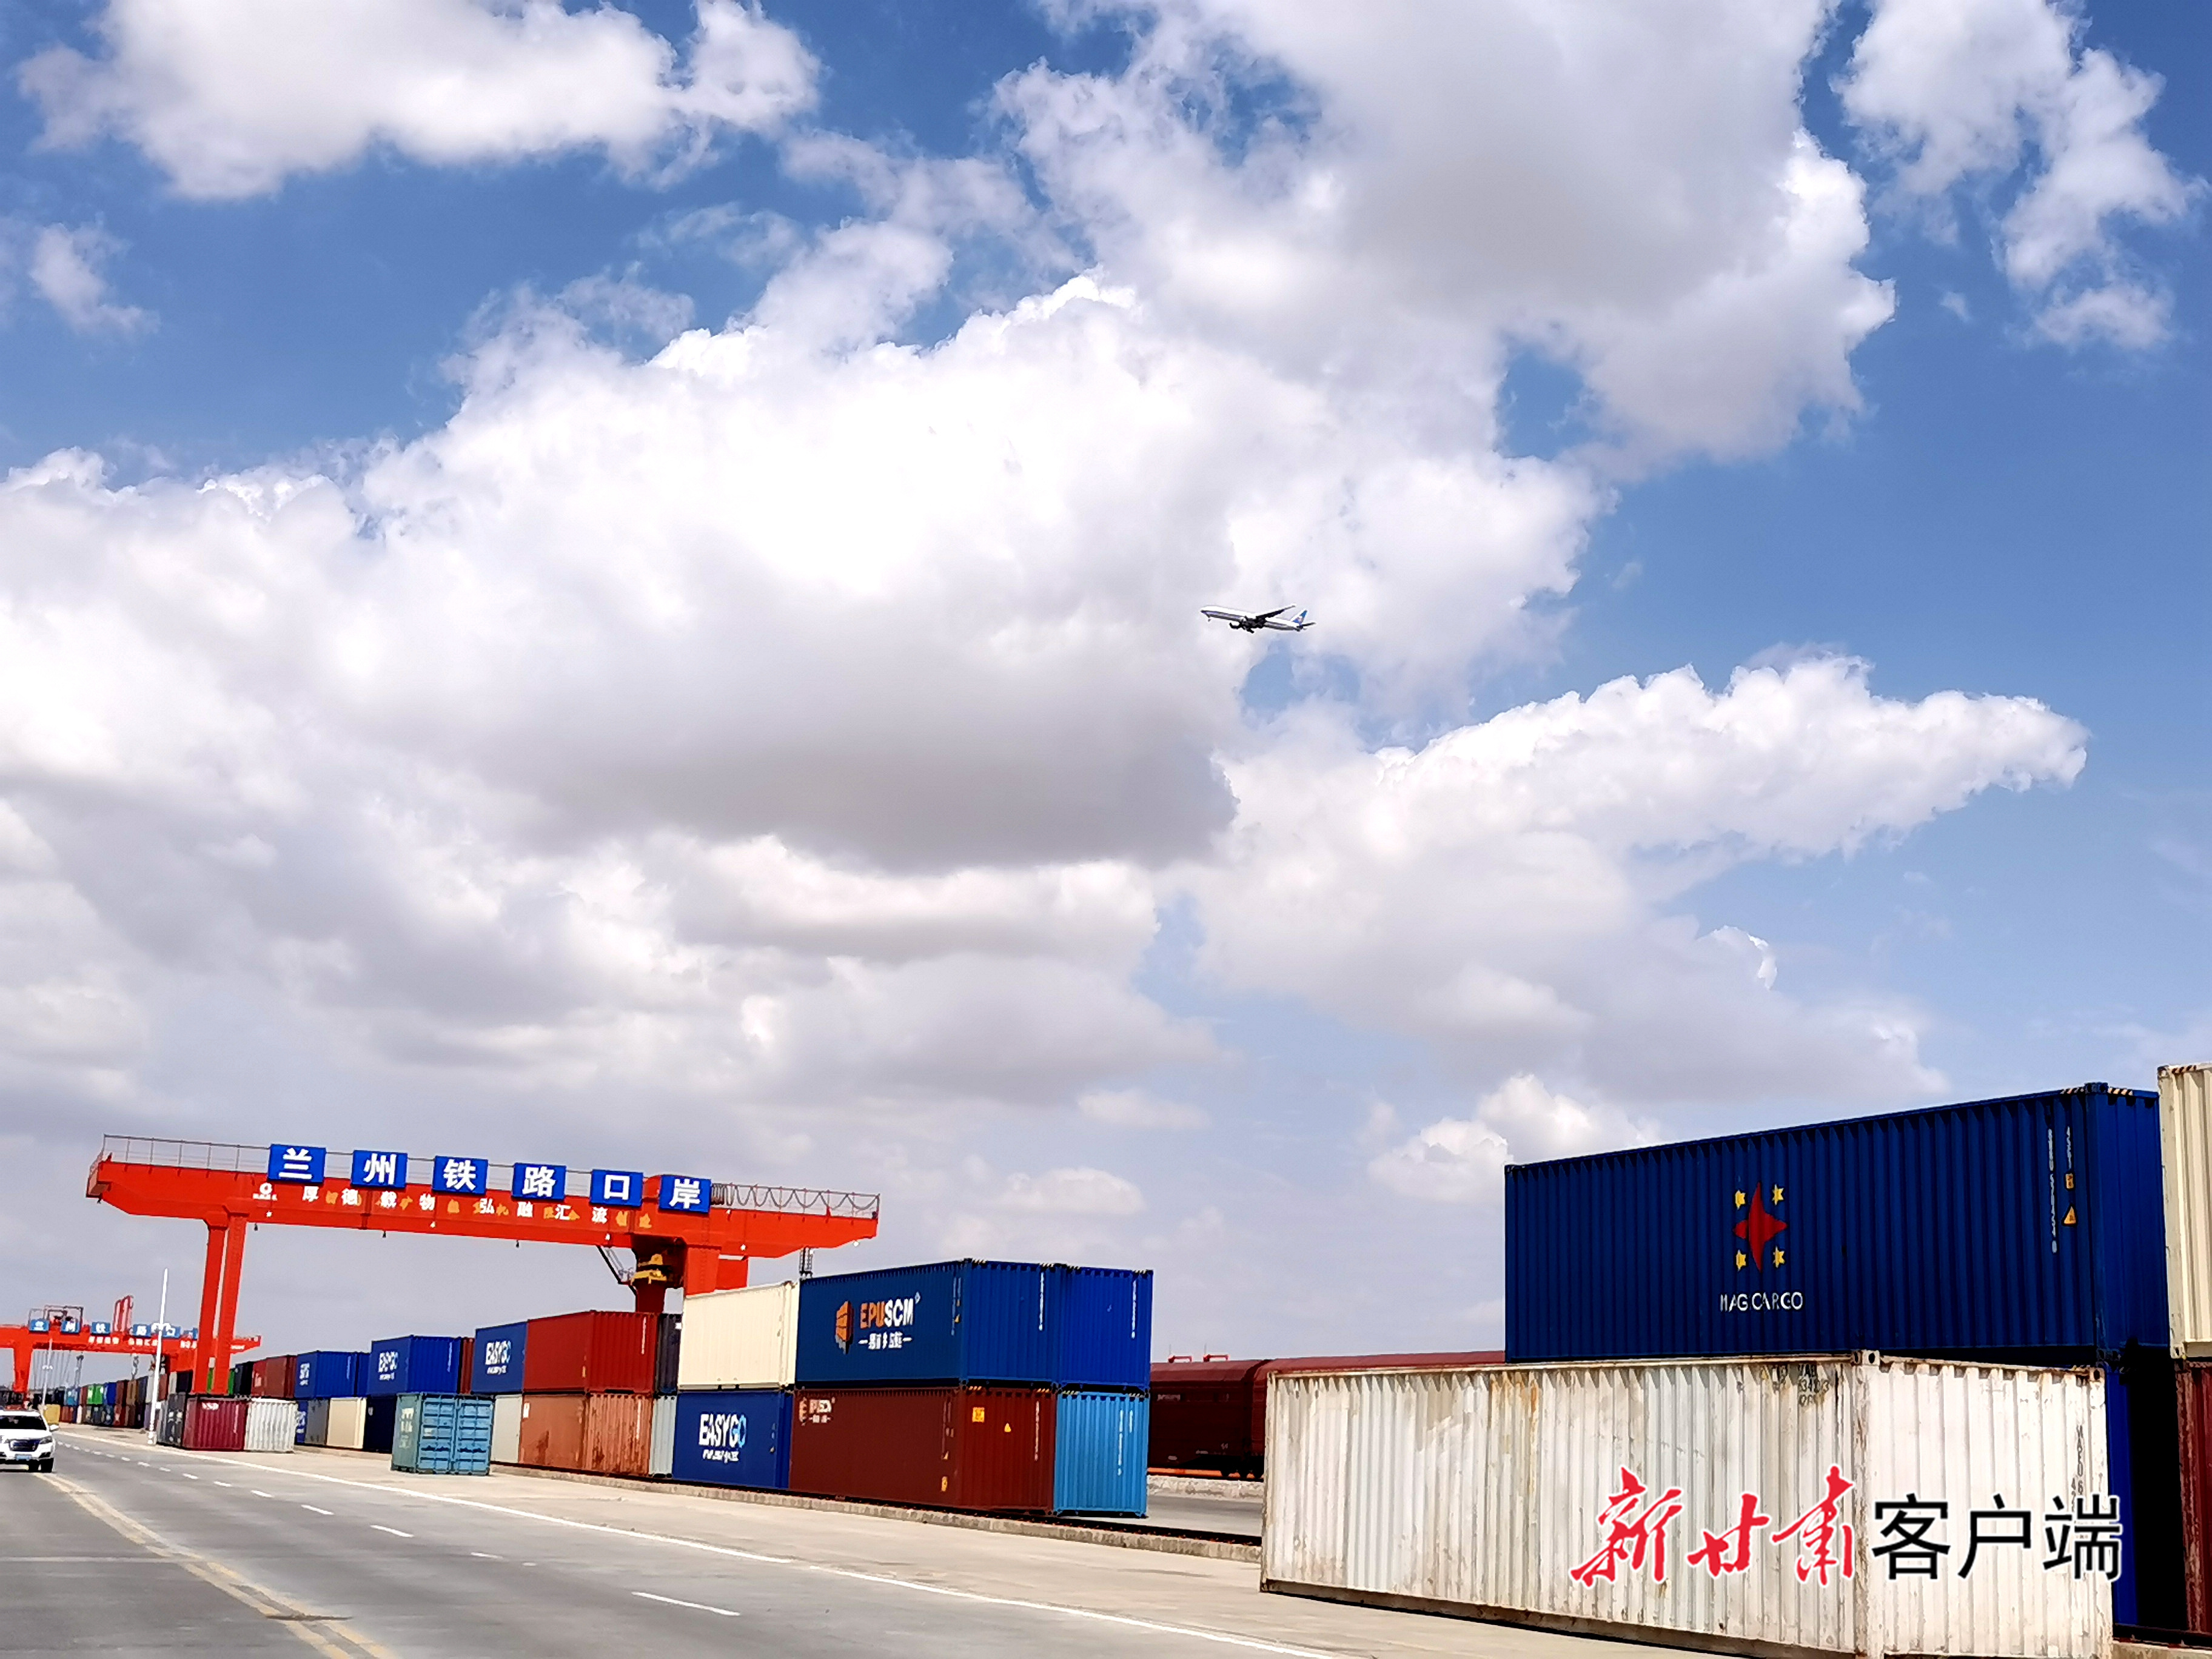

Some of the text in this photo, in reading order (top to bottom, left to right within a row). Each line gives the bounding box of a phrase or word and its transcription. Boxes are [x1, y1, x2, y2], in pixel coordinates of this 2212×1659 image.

[278, 1147, 701, 1209] 兰州铁路口岸
[860, 1298, 914, 1329] EPUSCM
[1720, 1292, 1803, 1312] MAGCARGO
[699, 1413, 747, 1448] EASYGO
